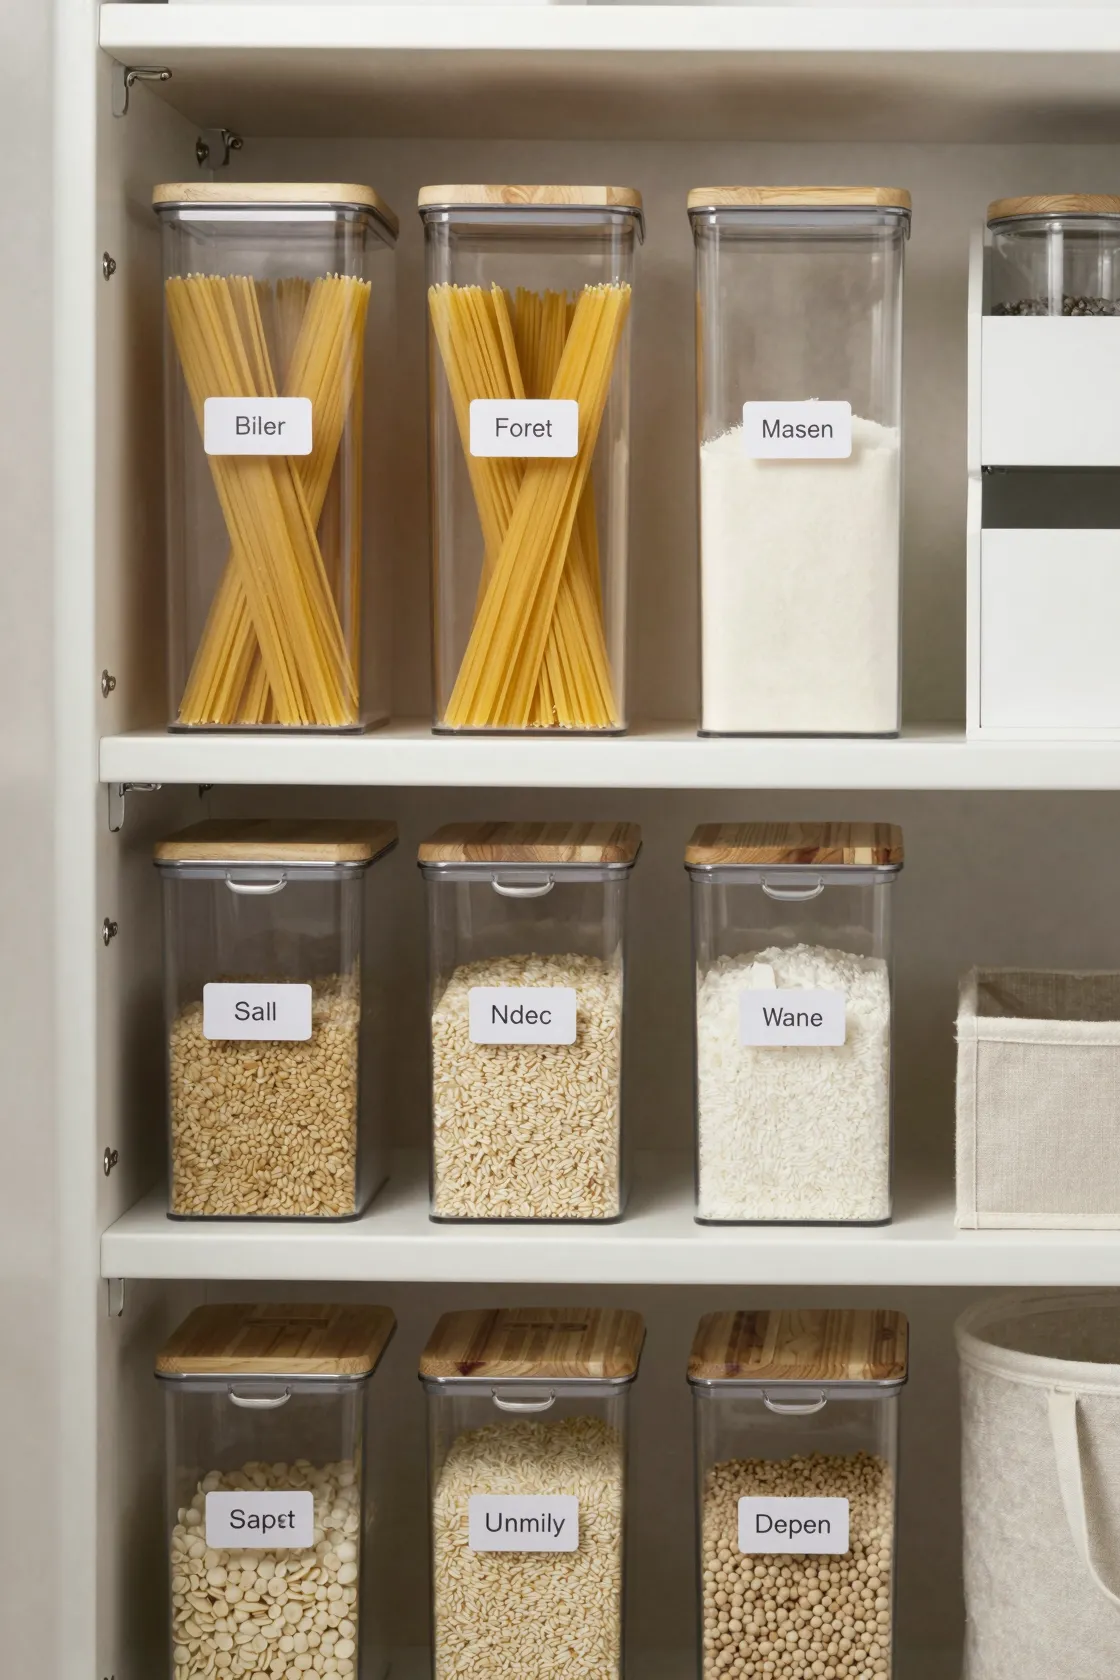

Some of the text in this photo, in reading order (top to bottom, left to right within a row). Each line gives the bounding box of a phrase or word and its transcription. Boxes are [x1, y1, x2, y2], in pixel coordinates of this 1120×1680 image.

[235, 415, 286, 436] Biler
[495, 417, 553, 438] Foret
[762, 419, 833, 439] Masen
[234, 1000, 276, 1022] Sall
[491, 1004, 552, 1025] Ndec
[762, 1007, 823, 1027] Wane
[485, 1512, 566, 1538] Unmily
[755, 1513, 831, 1539] Depen
